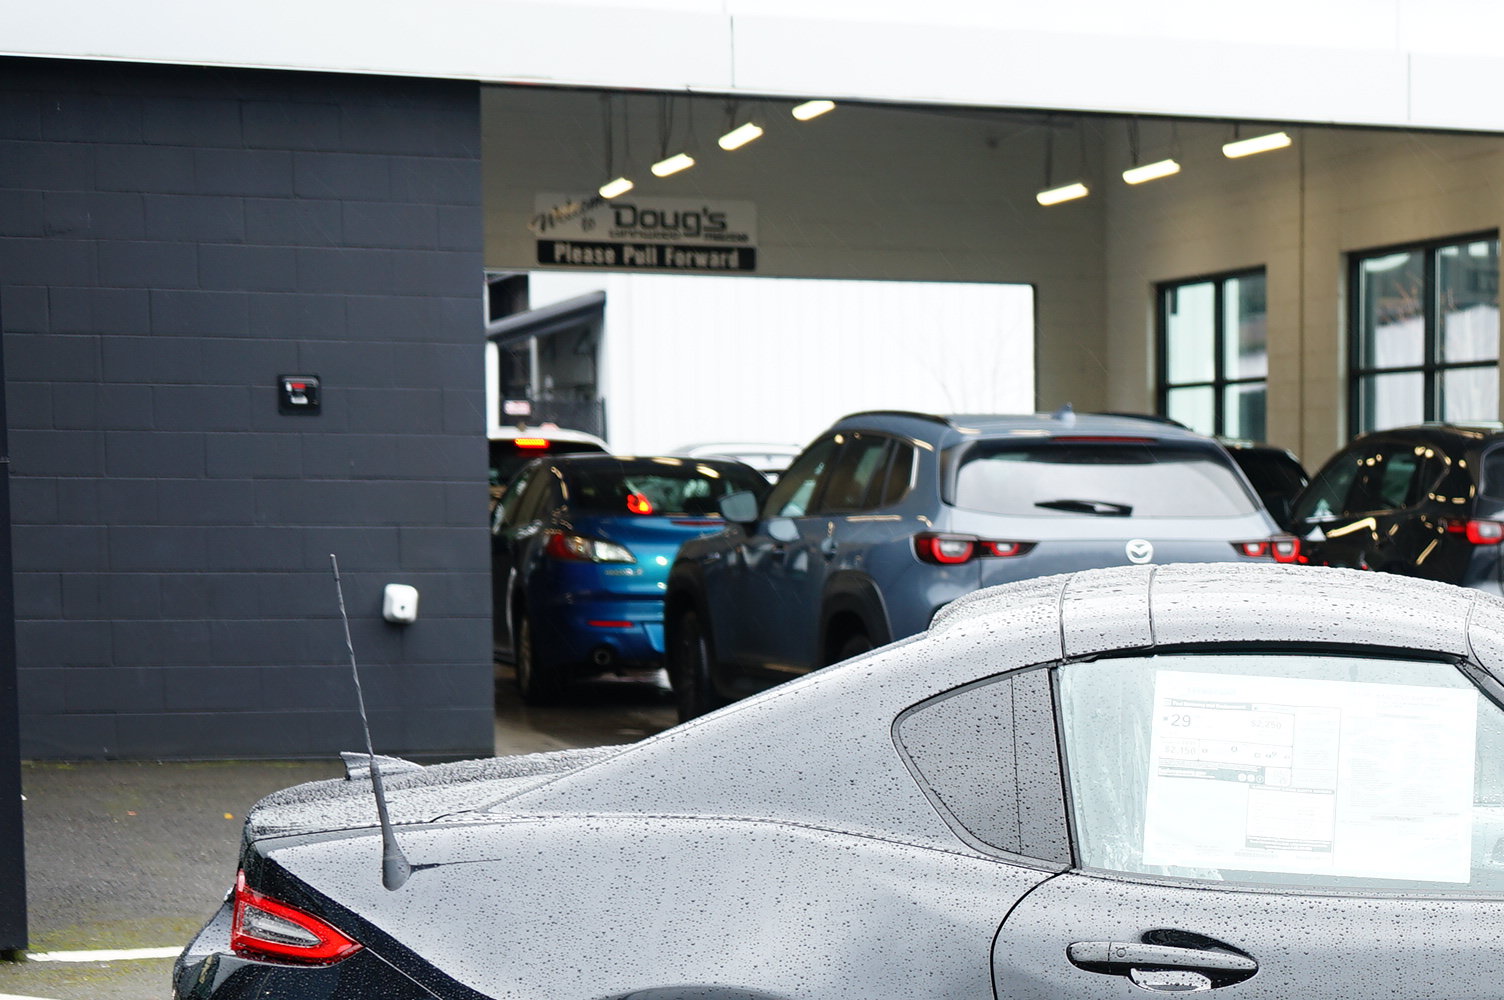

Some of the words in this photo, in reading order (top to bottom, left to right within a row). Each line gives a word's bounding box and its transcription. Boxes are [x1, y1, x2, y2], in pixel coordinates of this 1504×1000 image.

[609, 203, 728, 238] Doug's
[553, 241, 616, 264] Please
[622, 245, 658, 267] Pull
[665, 247, 740, 269] Forward
[1170, 713, 1192, 728] 29
